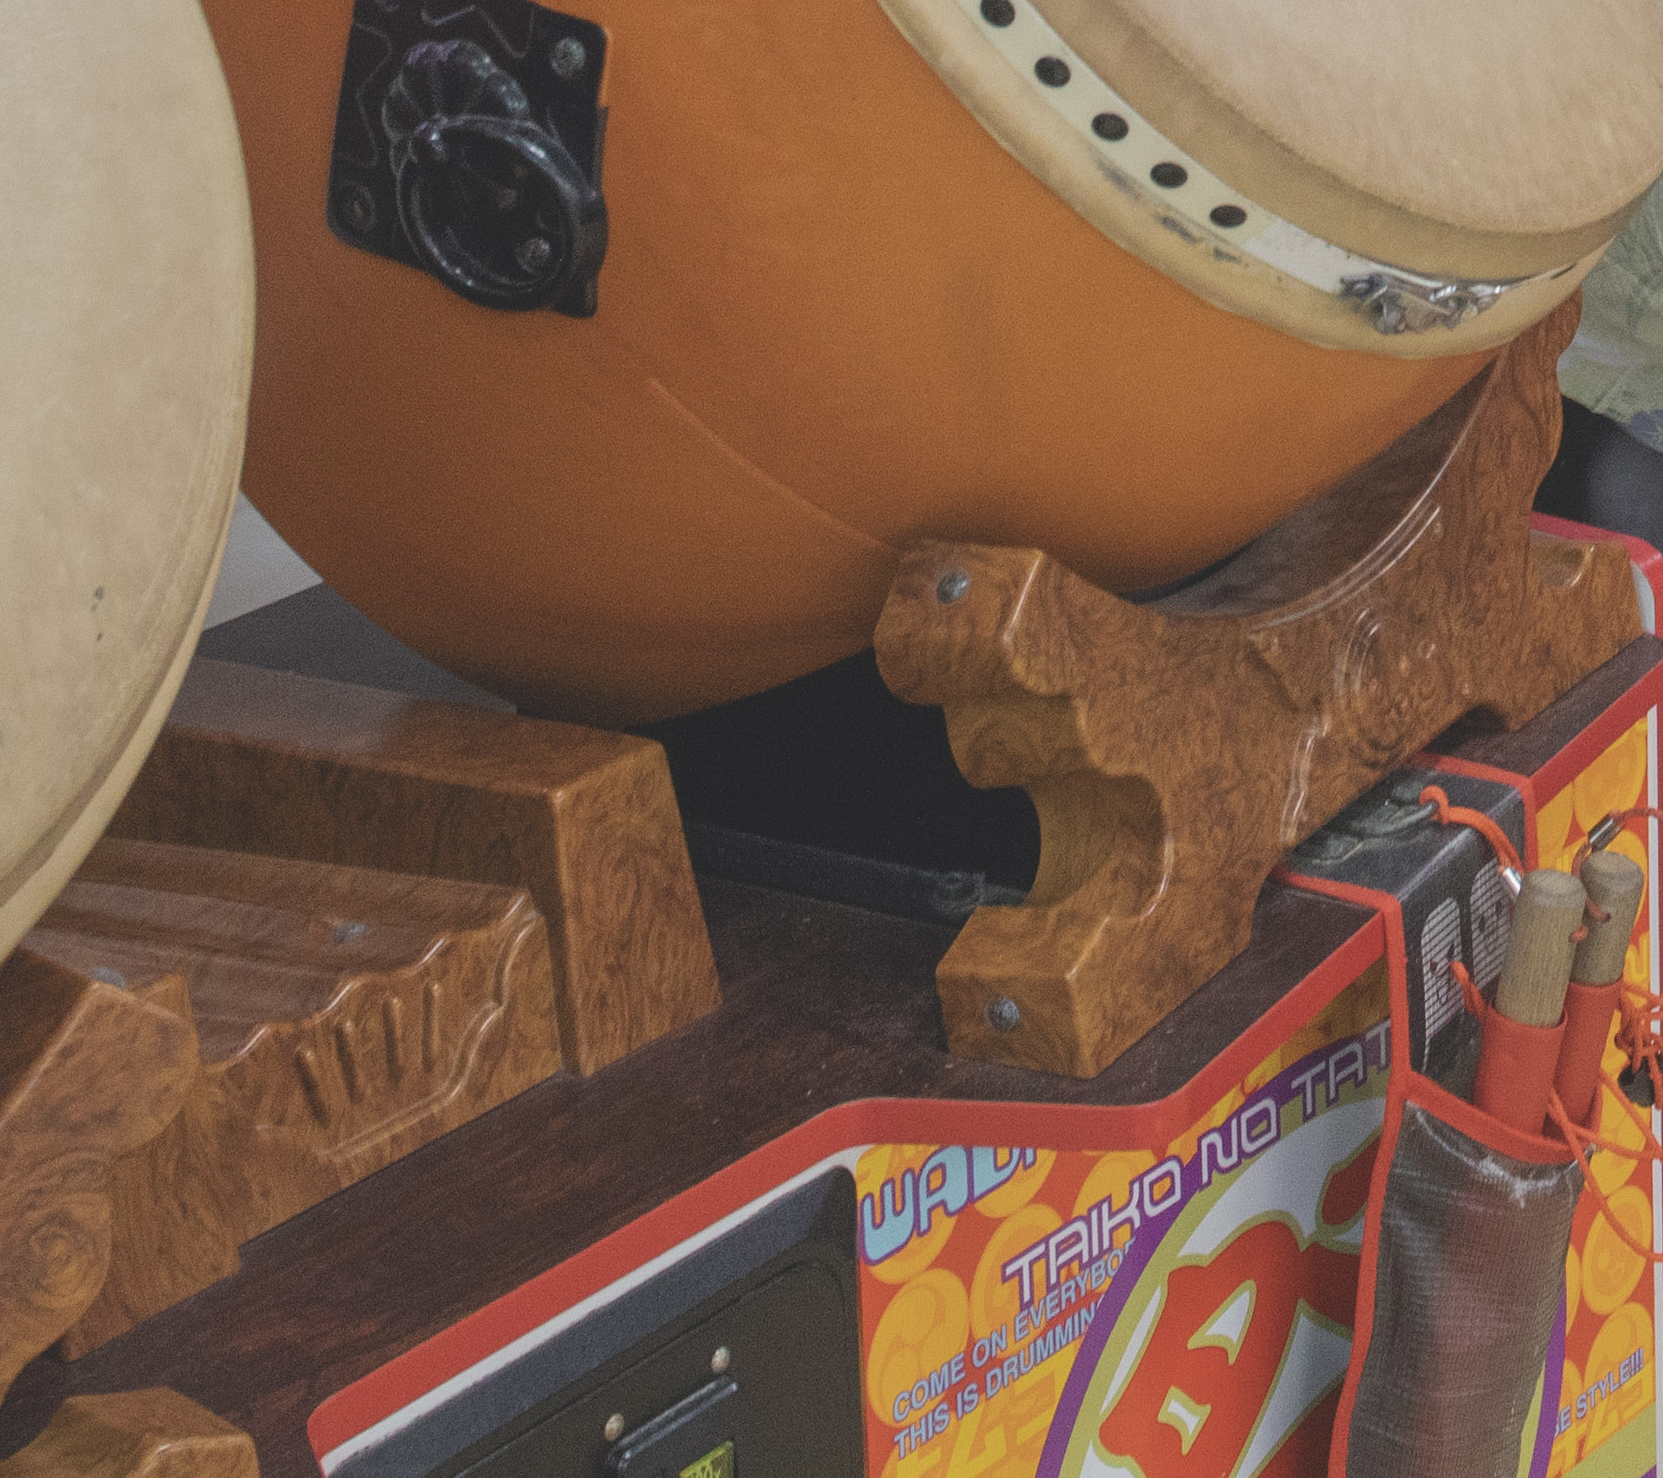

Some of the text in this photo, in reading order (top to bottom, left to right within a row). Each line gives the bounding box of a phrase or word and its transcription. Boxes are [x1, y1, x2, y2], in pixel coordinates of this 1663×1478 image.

[1002, 1149, 1186, 1314] TAIKO
[1196, 1088, 1283, 1193] NO
[892, 1349, 967, 1423] COME
[972, 1323, 1008, 1368] ON
[892, 1293, 1105, 1459] THIS IS DRUMMIN
[1576, 1346, 1644, 1420] STYLE!!!
